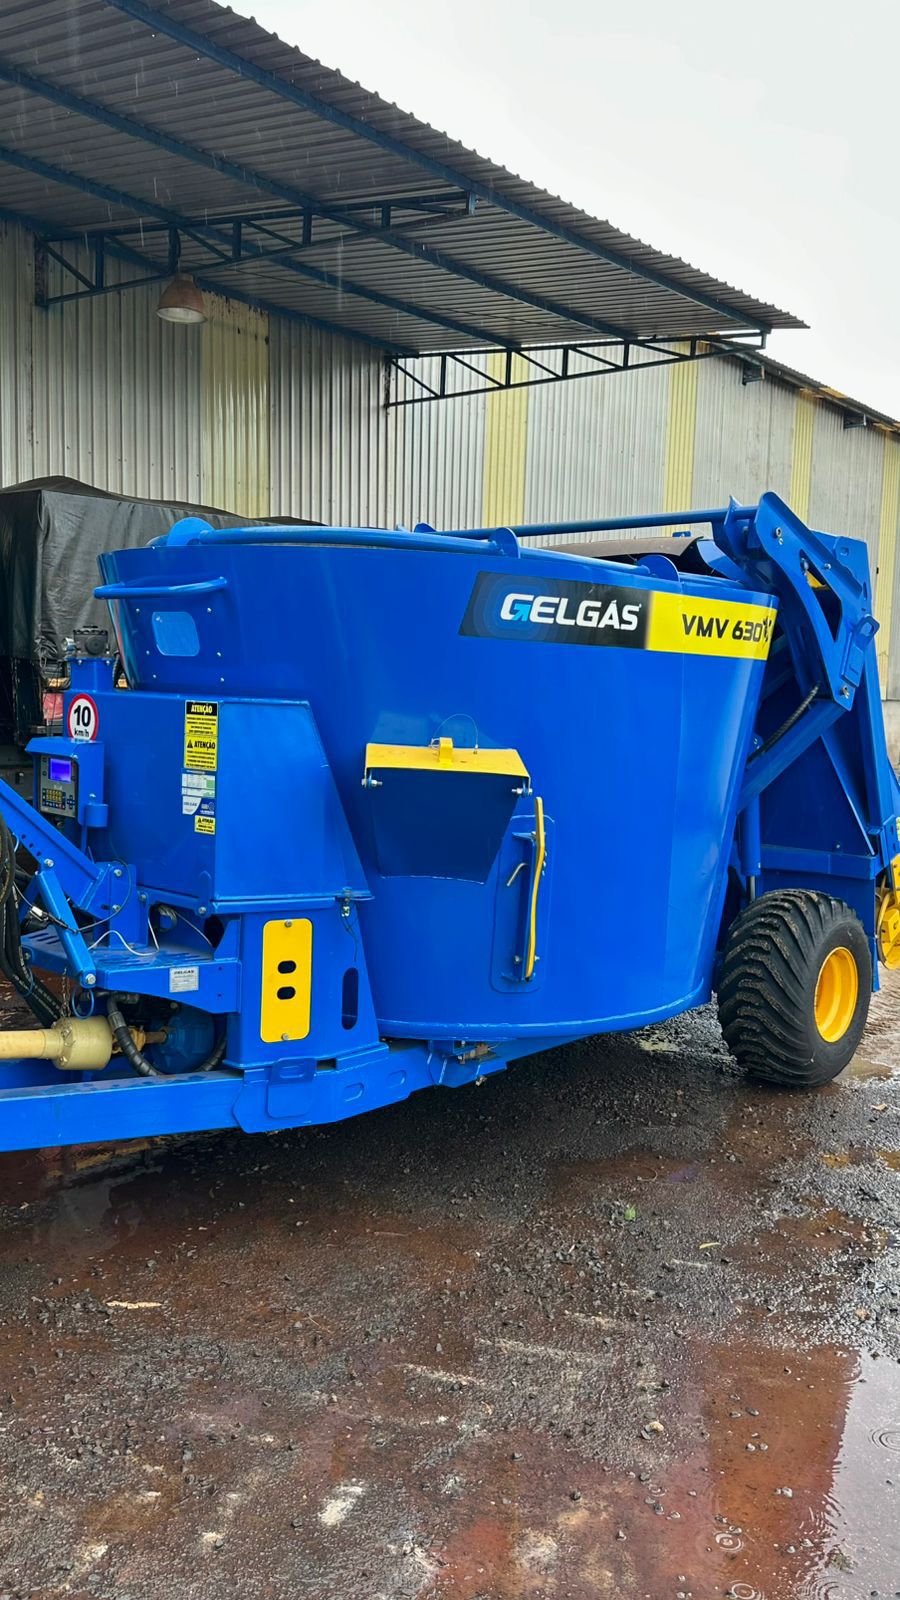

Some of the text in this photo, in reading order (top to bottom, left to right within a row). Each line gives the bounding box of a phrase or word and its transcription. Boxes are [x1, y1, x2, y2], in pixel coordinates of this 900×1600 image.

[682, 613, 762, 643] VMV 630
[74, 705, 91, 727] 10
[190, 703, 213, 716] ATENÇÃO
[193, 740, 215, 751] ATENÇÃO
